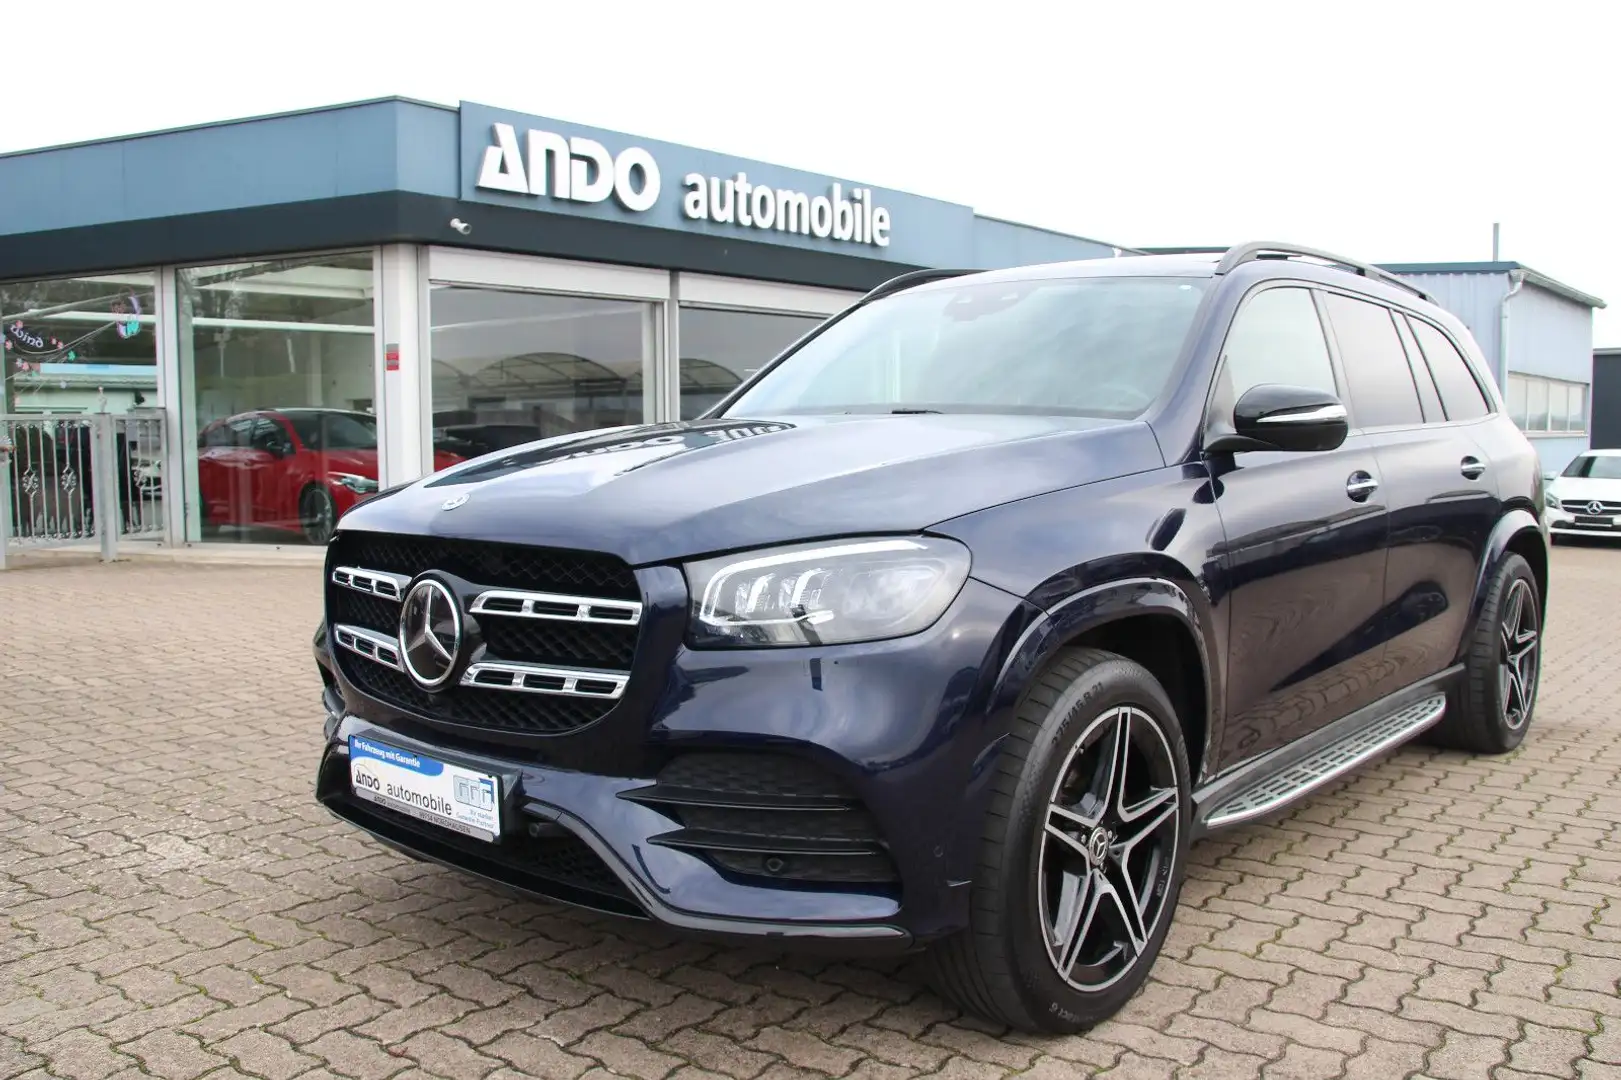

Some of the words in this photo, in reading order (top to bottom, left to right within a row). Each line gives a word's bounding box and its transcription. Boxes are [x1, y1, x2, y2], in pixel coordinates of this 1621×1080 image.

[682, 170, 891, 247] automobile
[361, 741, 385, 760] Fahrzeug
[385, 750, 396, 761] mit
[395, 753, 421, 768] Garantie
[387, 783, 452, 815] automobile
